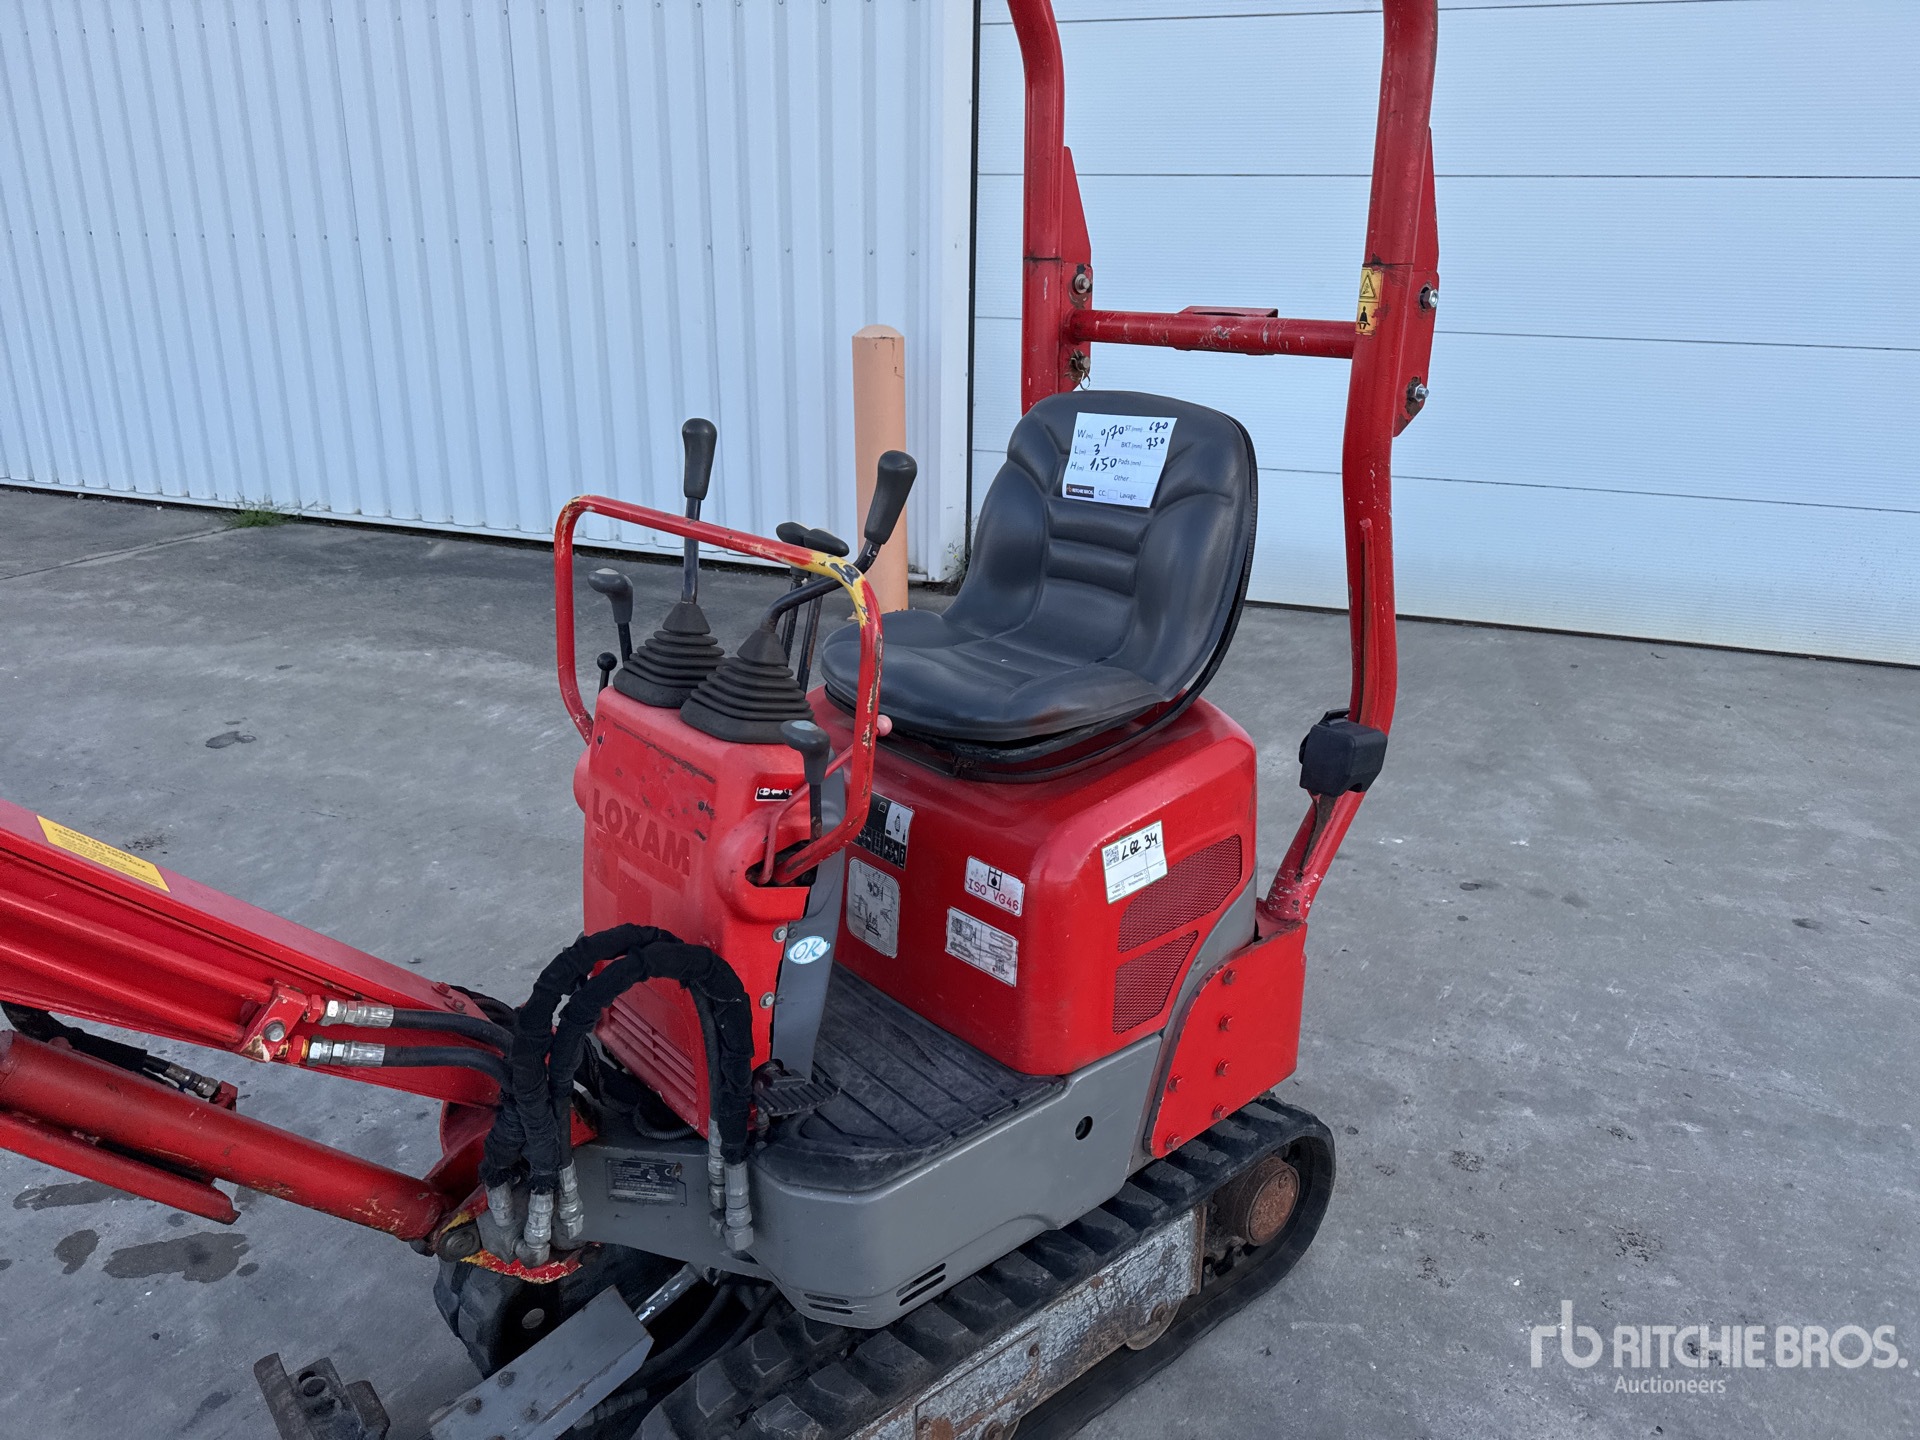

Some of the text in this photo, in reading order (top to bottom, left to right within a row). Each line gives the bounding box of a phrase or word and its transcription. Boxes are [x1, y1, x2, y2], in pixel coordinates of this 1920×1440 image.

[1094, 443, 1100, 455] 3
[592, 787, 692, 878] LOXAM
[1144, 832, 1158, 850] 34
[968, 878, 1019, 911] ISO VG46
[794, 940, 822, 960] OK
